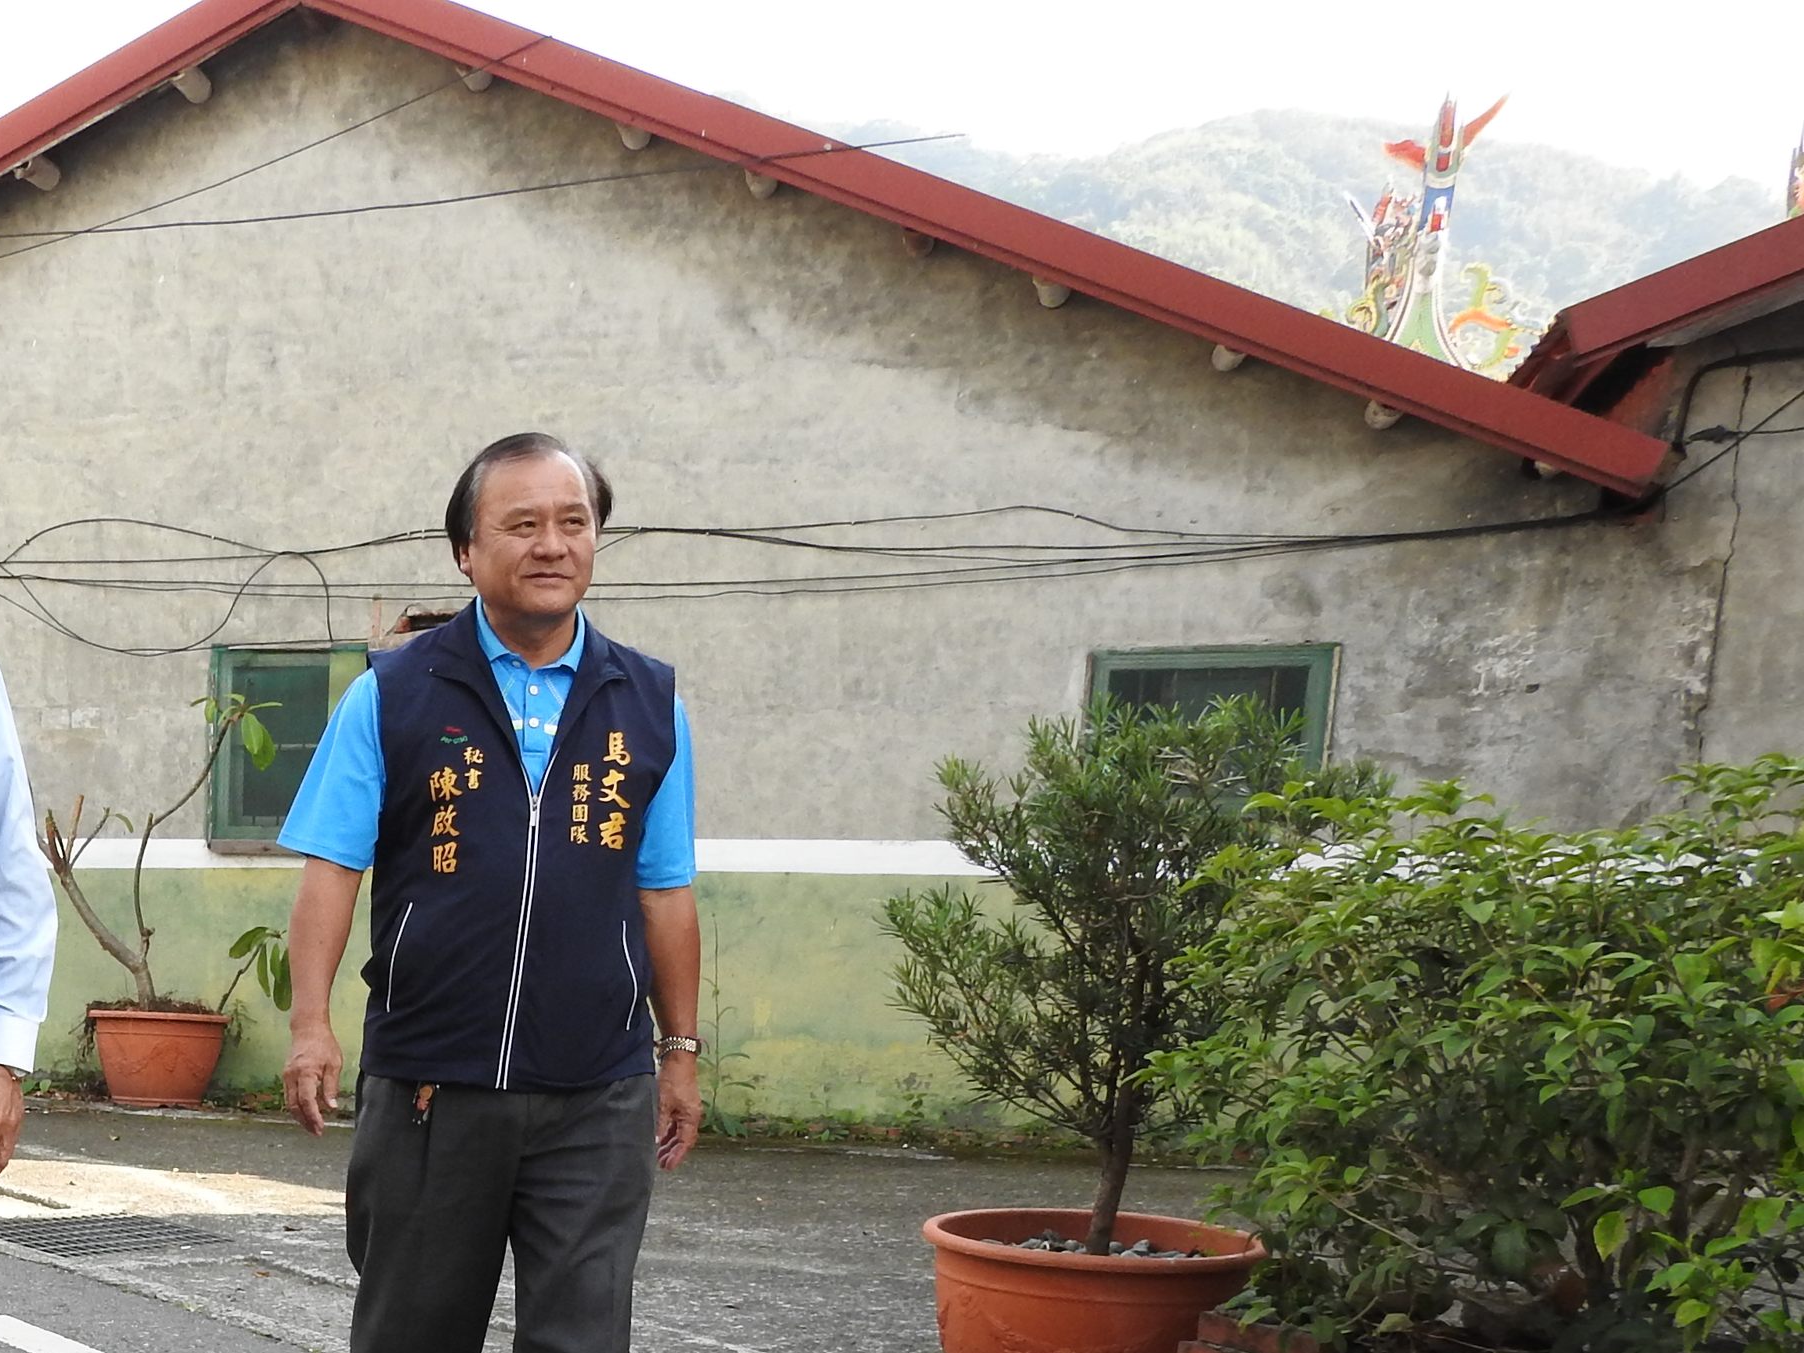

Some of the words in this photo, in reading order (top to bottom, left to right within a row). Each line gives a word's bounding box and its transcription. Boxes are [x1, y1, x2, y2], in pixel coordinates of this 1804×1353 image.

[463, 746, 484, 790] 秘書
[570, 764, 592, 844] 服務團隊
[599, 732, 631, 850] 馬文君
